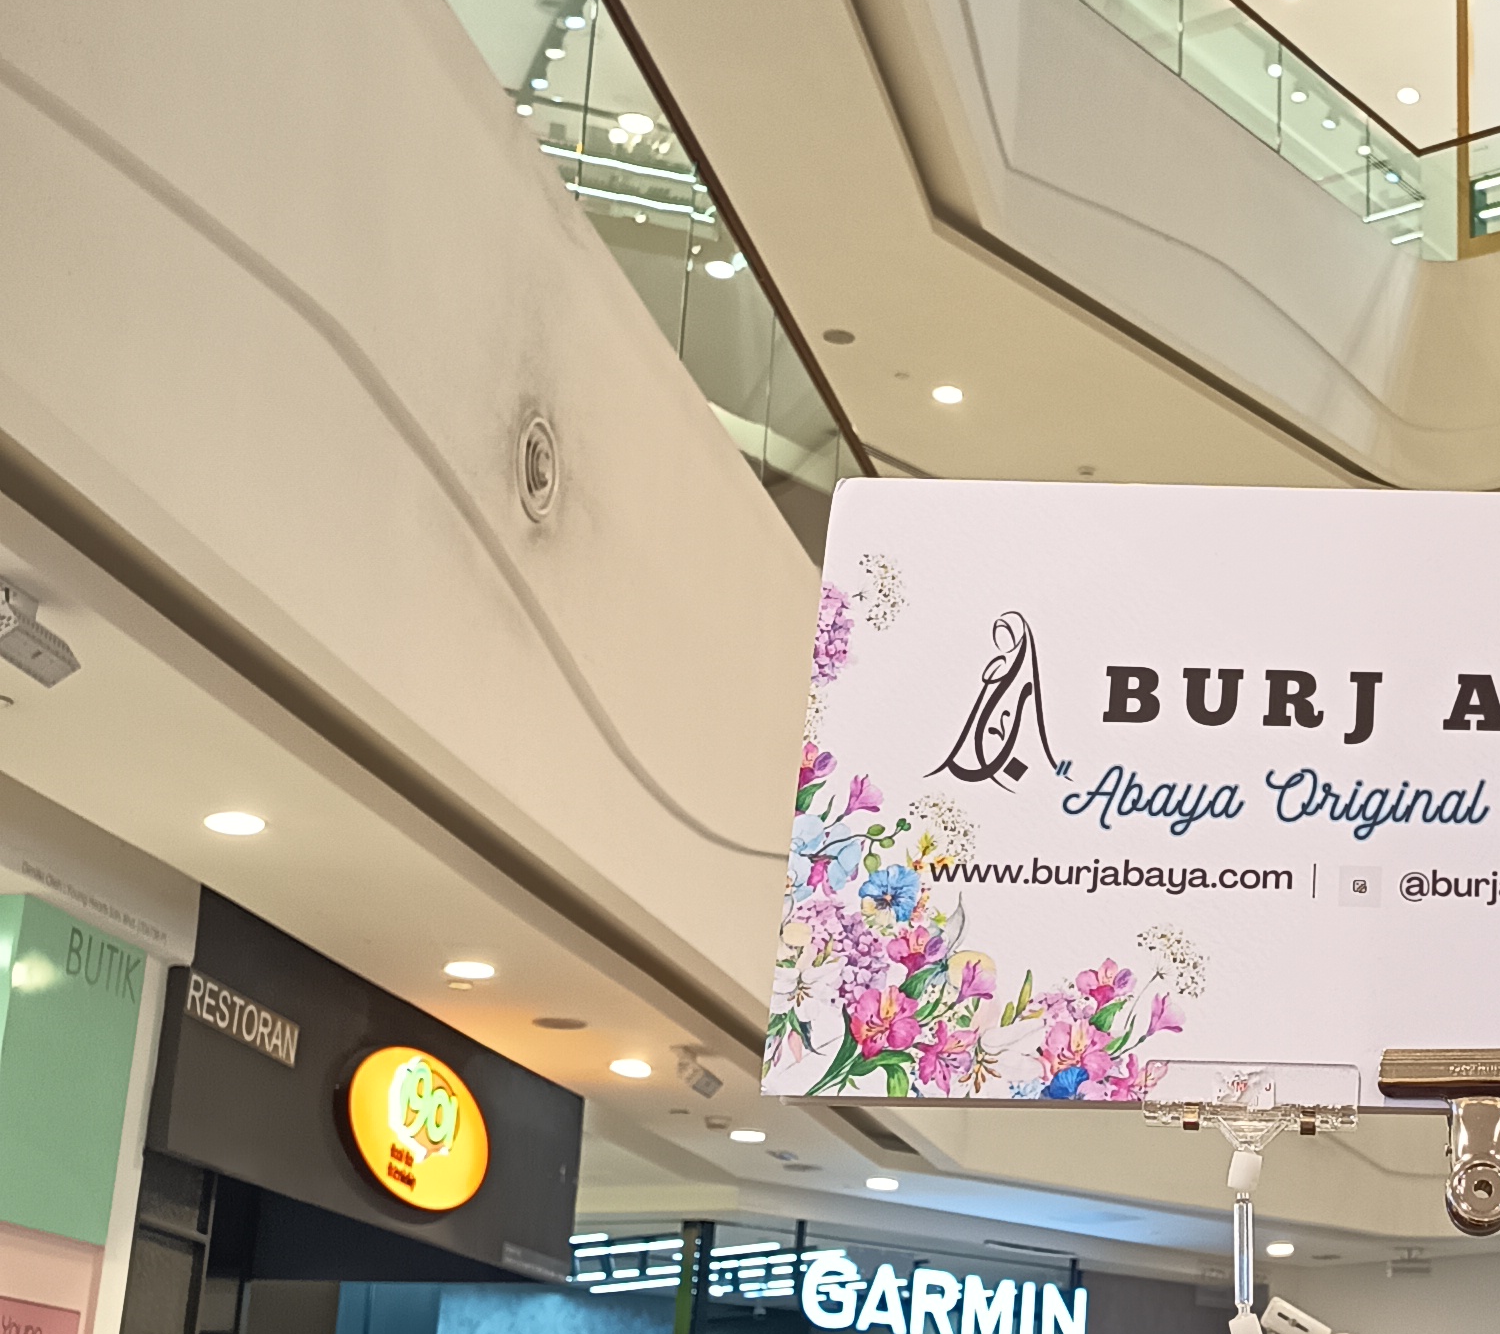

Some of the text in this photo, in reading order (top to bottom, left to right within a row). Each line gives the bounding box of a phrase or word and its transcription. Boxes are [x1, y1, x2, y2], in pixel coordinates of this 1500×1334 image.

[1102, 664, 1384, 745] BURJ
[1054, 759, 1246, 838] "Abaya
[1264, 766, 1490, 842] Original
[929, 858, 1294, 896] www.burjabaya.com
[66, 925, 142, 1004] BUTIK
[186, 972, 299, 1066] RESTORAN
